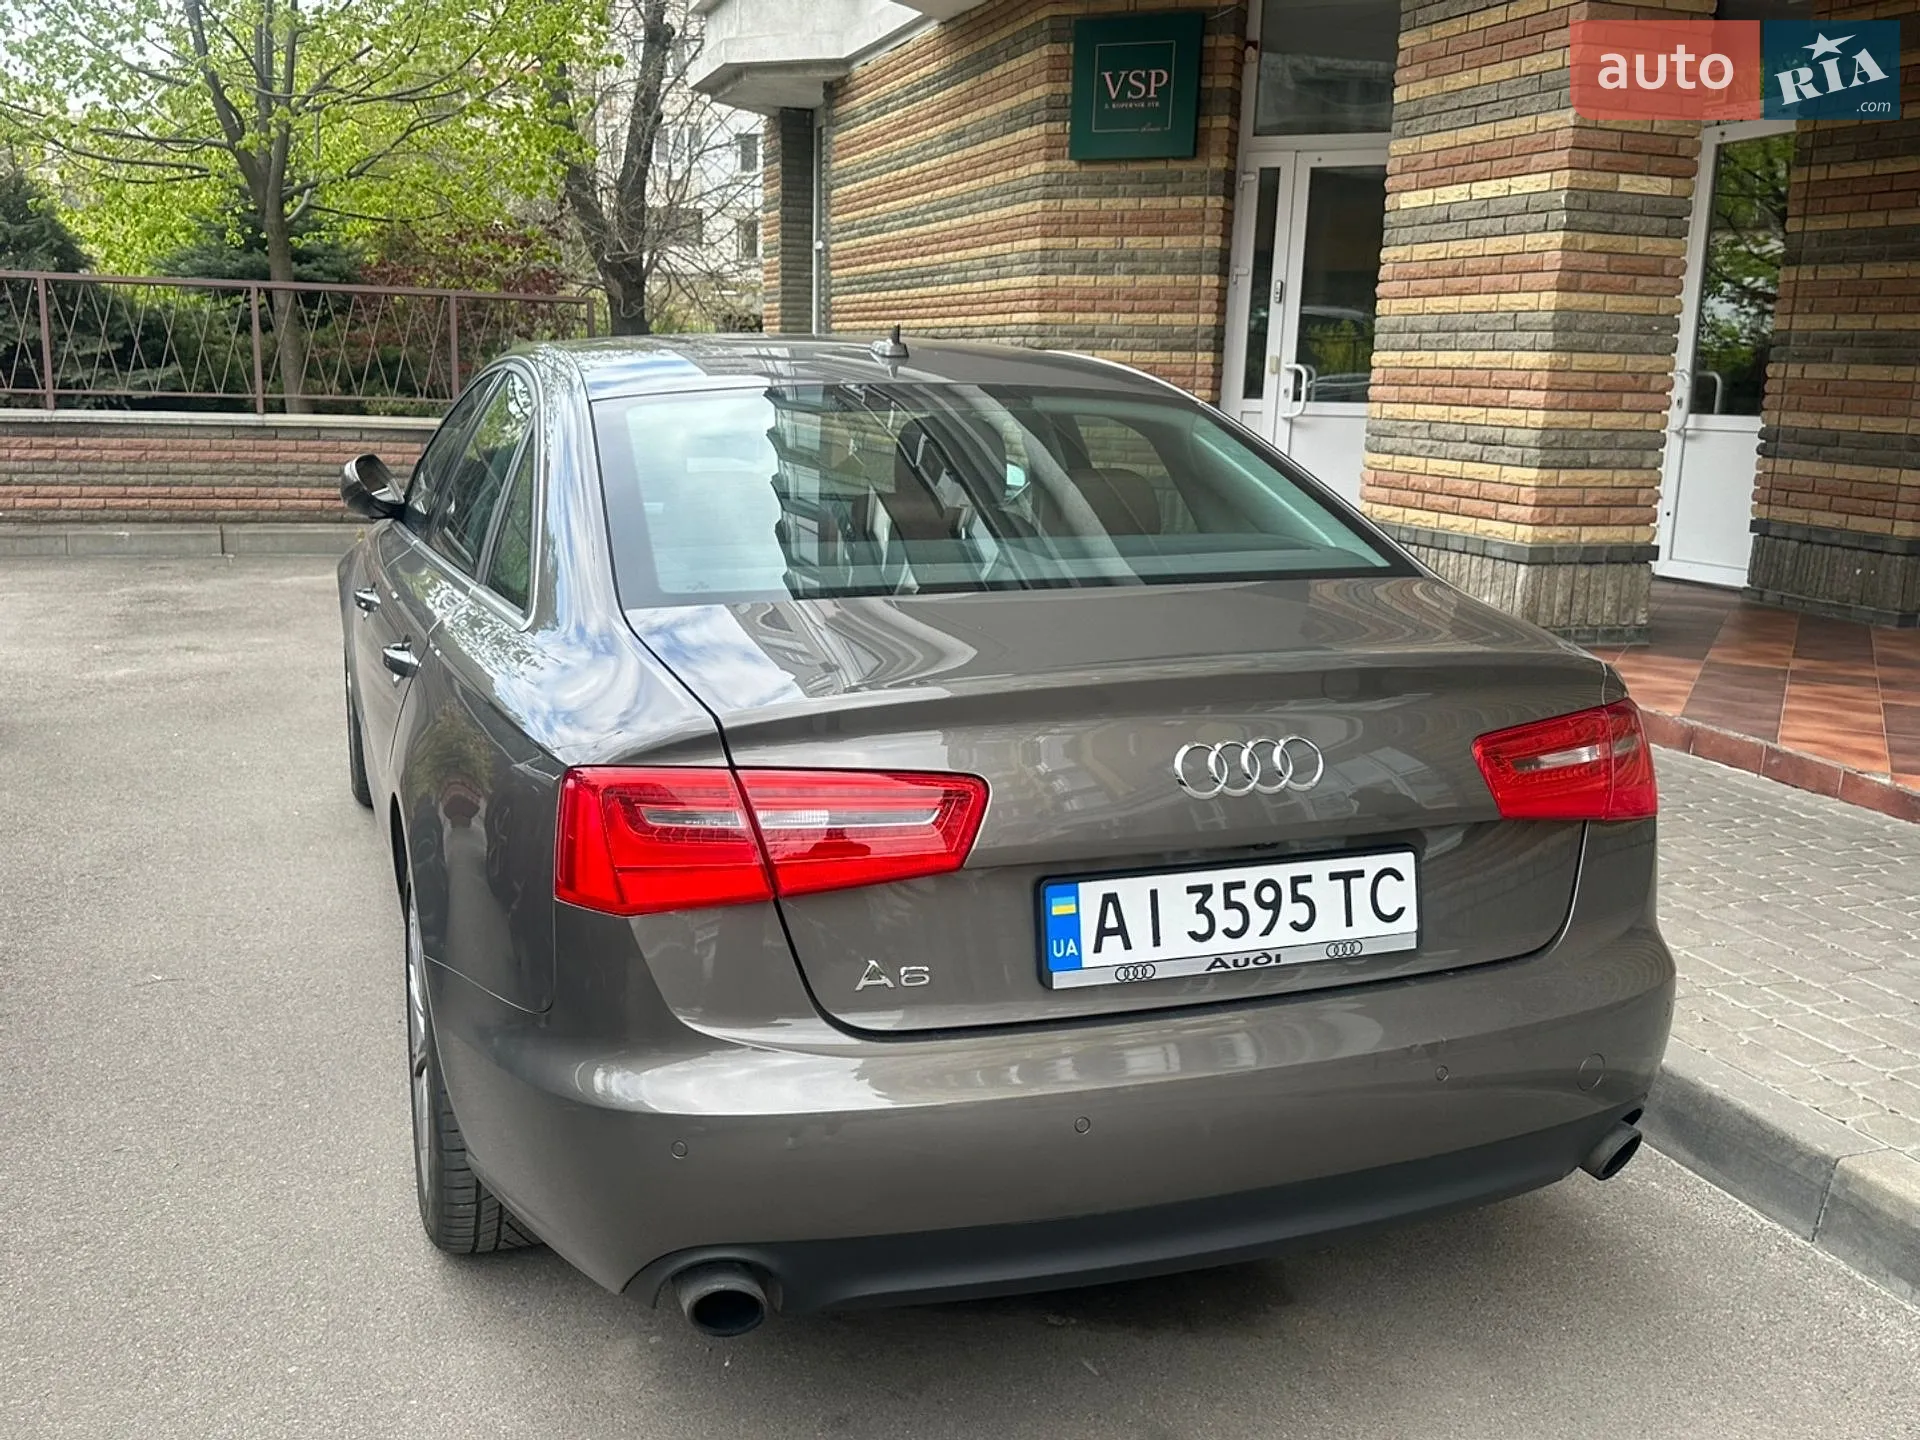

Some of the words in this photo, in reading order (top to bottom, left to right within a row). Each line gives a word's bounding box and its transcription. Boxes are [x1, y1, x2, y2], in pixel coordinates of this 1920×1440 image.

[1101, 69, 1169, 100] VSP
[1093, 888, 1161, 954] AI
[1186, 874, 1317, 943] 3595
[1329, 867, 1406, 929] TC
[1053, 940, 1079, 958] UA
[1204, 951, 1282, 972] Audi
[855, 960, 930, 991] A6
